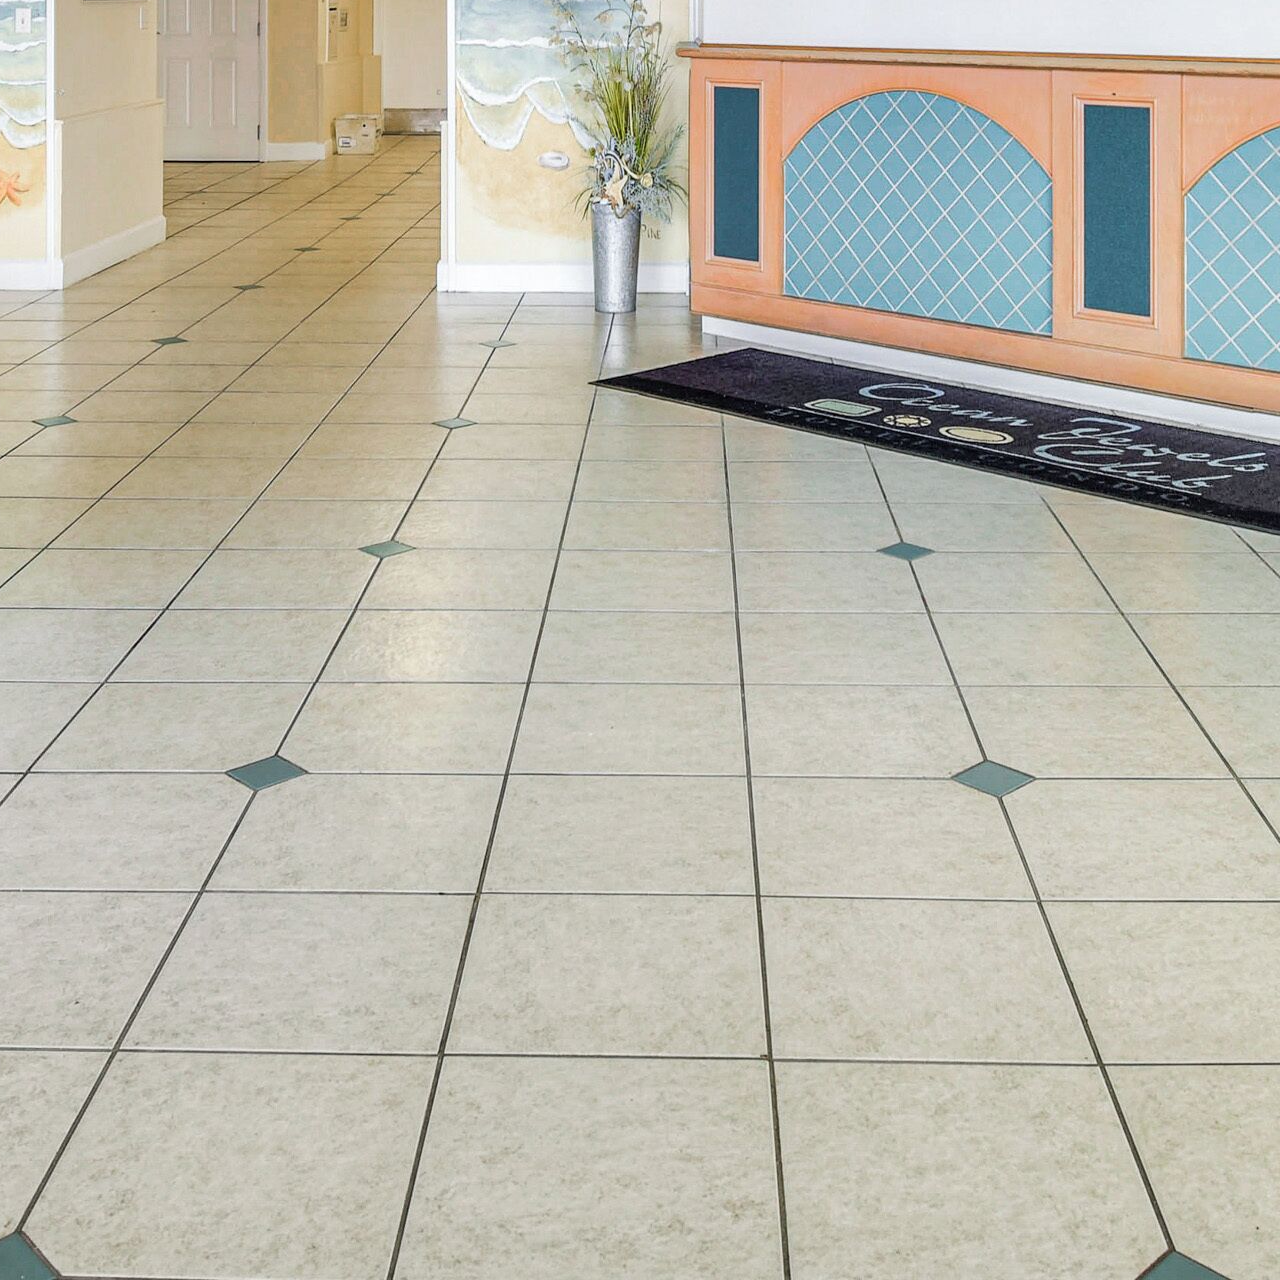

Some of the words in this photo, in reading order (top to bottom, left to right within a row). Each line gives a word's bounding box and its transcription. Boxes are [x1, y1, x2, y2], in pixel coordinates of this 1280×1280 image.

[859, 382, 1034, 427] Ocean
[1037, 417, 1269, 472] Jewels
[1033, 443, 1233, 489] Club
